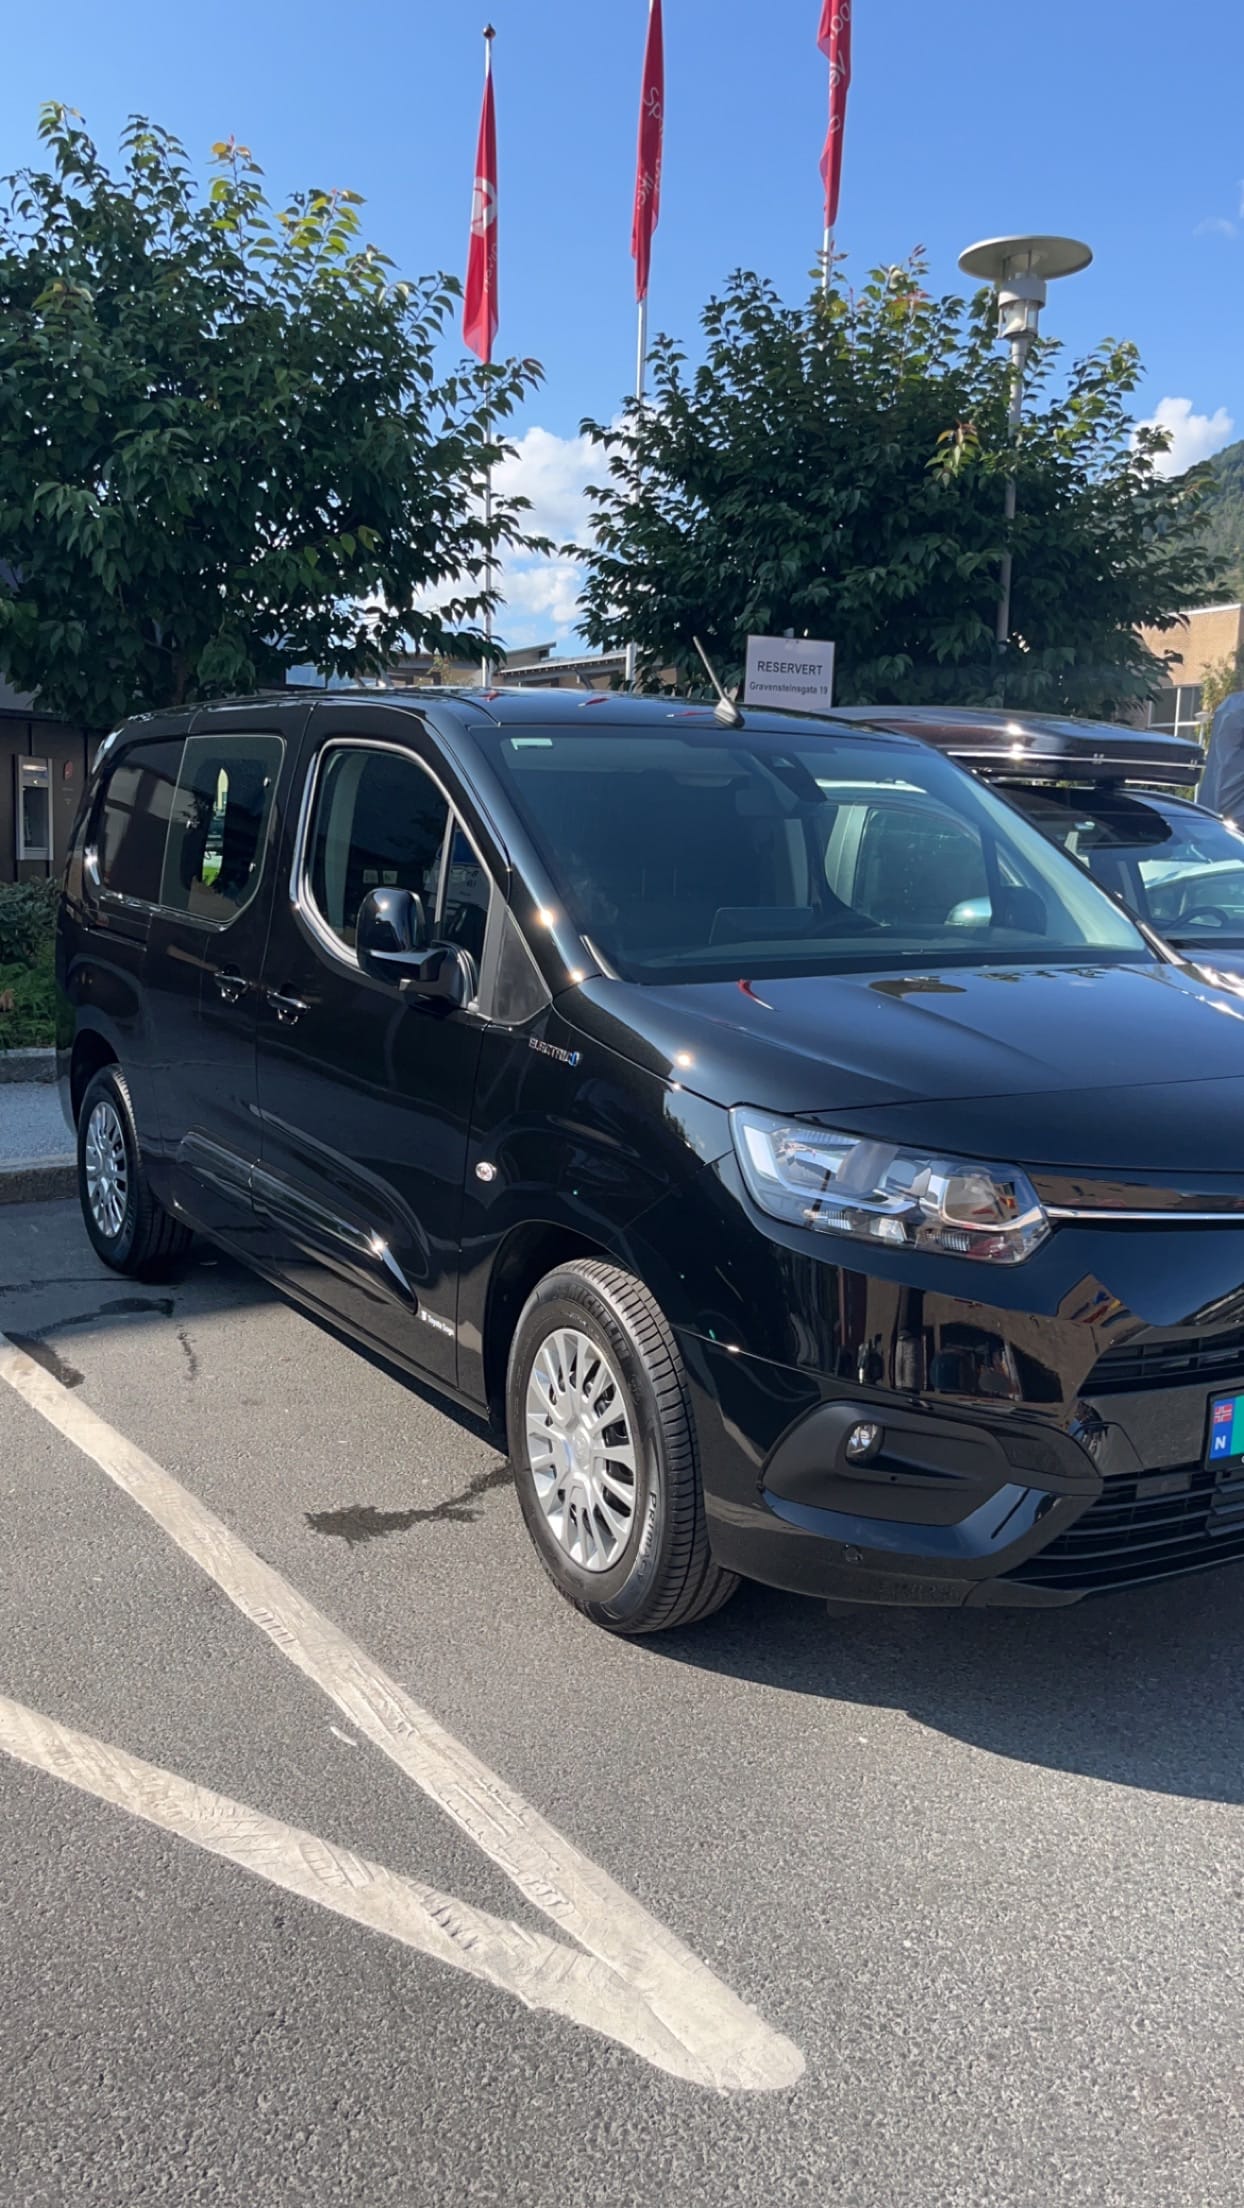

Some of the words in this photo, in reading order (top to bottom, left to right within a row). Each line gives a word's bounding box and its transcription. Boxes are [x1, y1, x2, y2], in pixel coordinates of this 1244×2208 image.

[757, 661, 823, 676] RESERVERT
[820, 686, 828, 695] 19
[568, 1283, 630, 1359] MICHELIN
[1214, 1435, 1226, 1450] N
